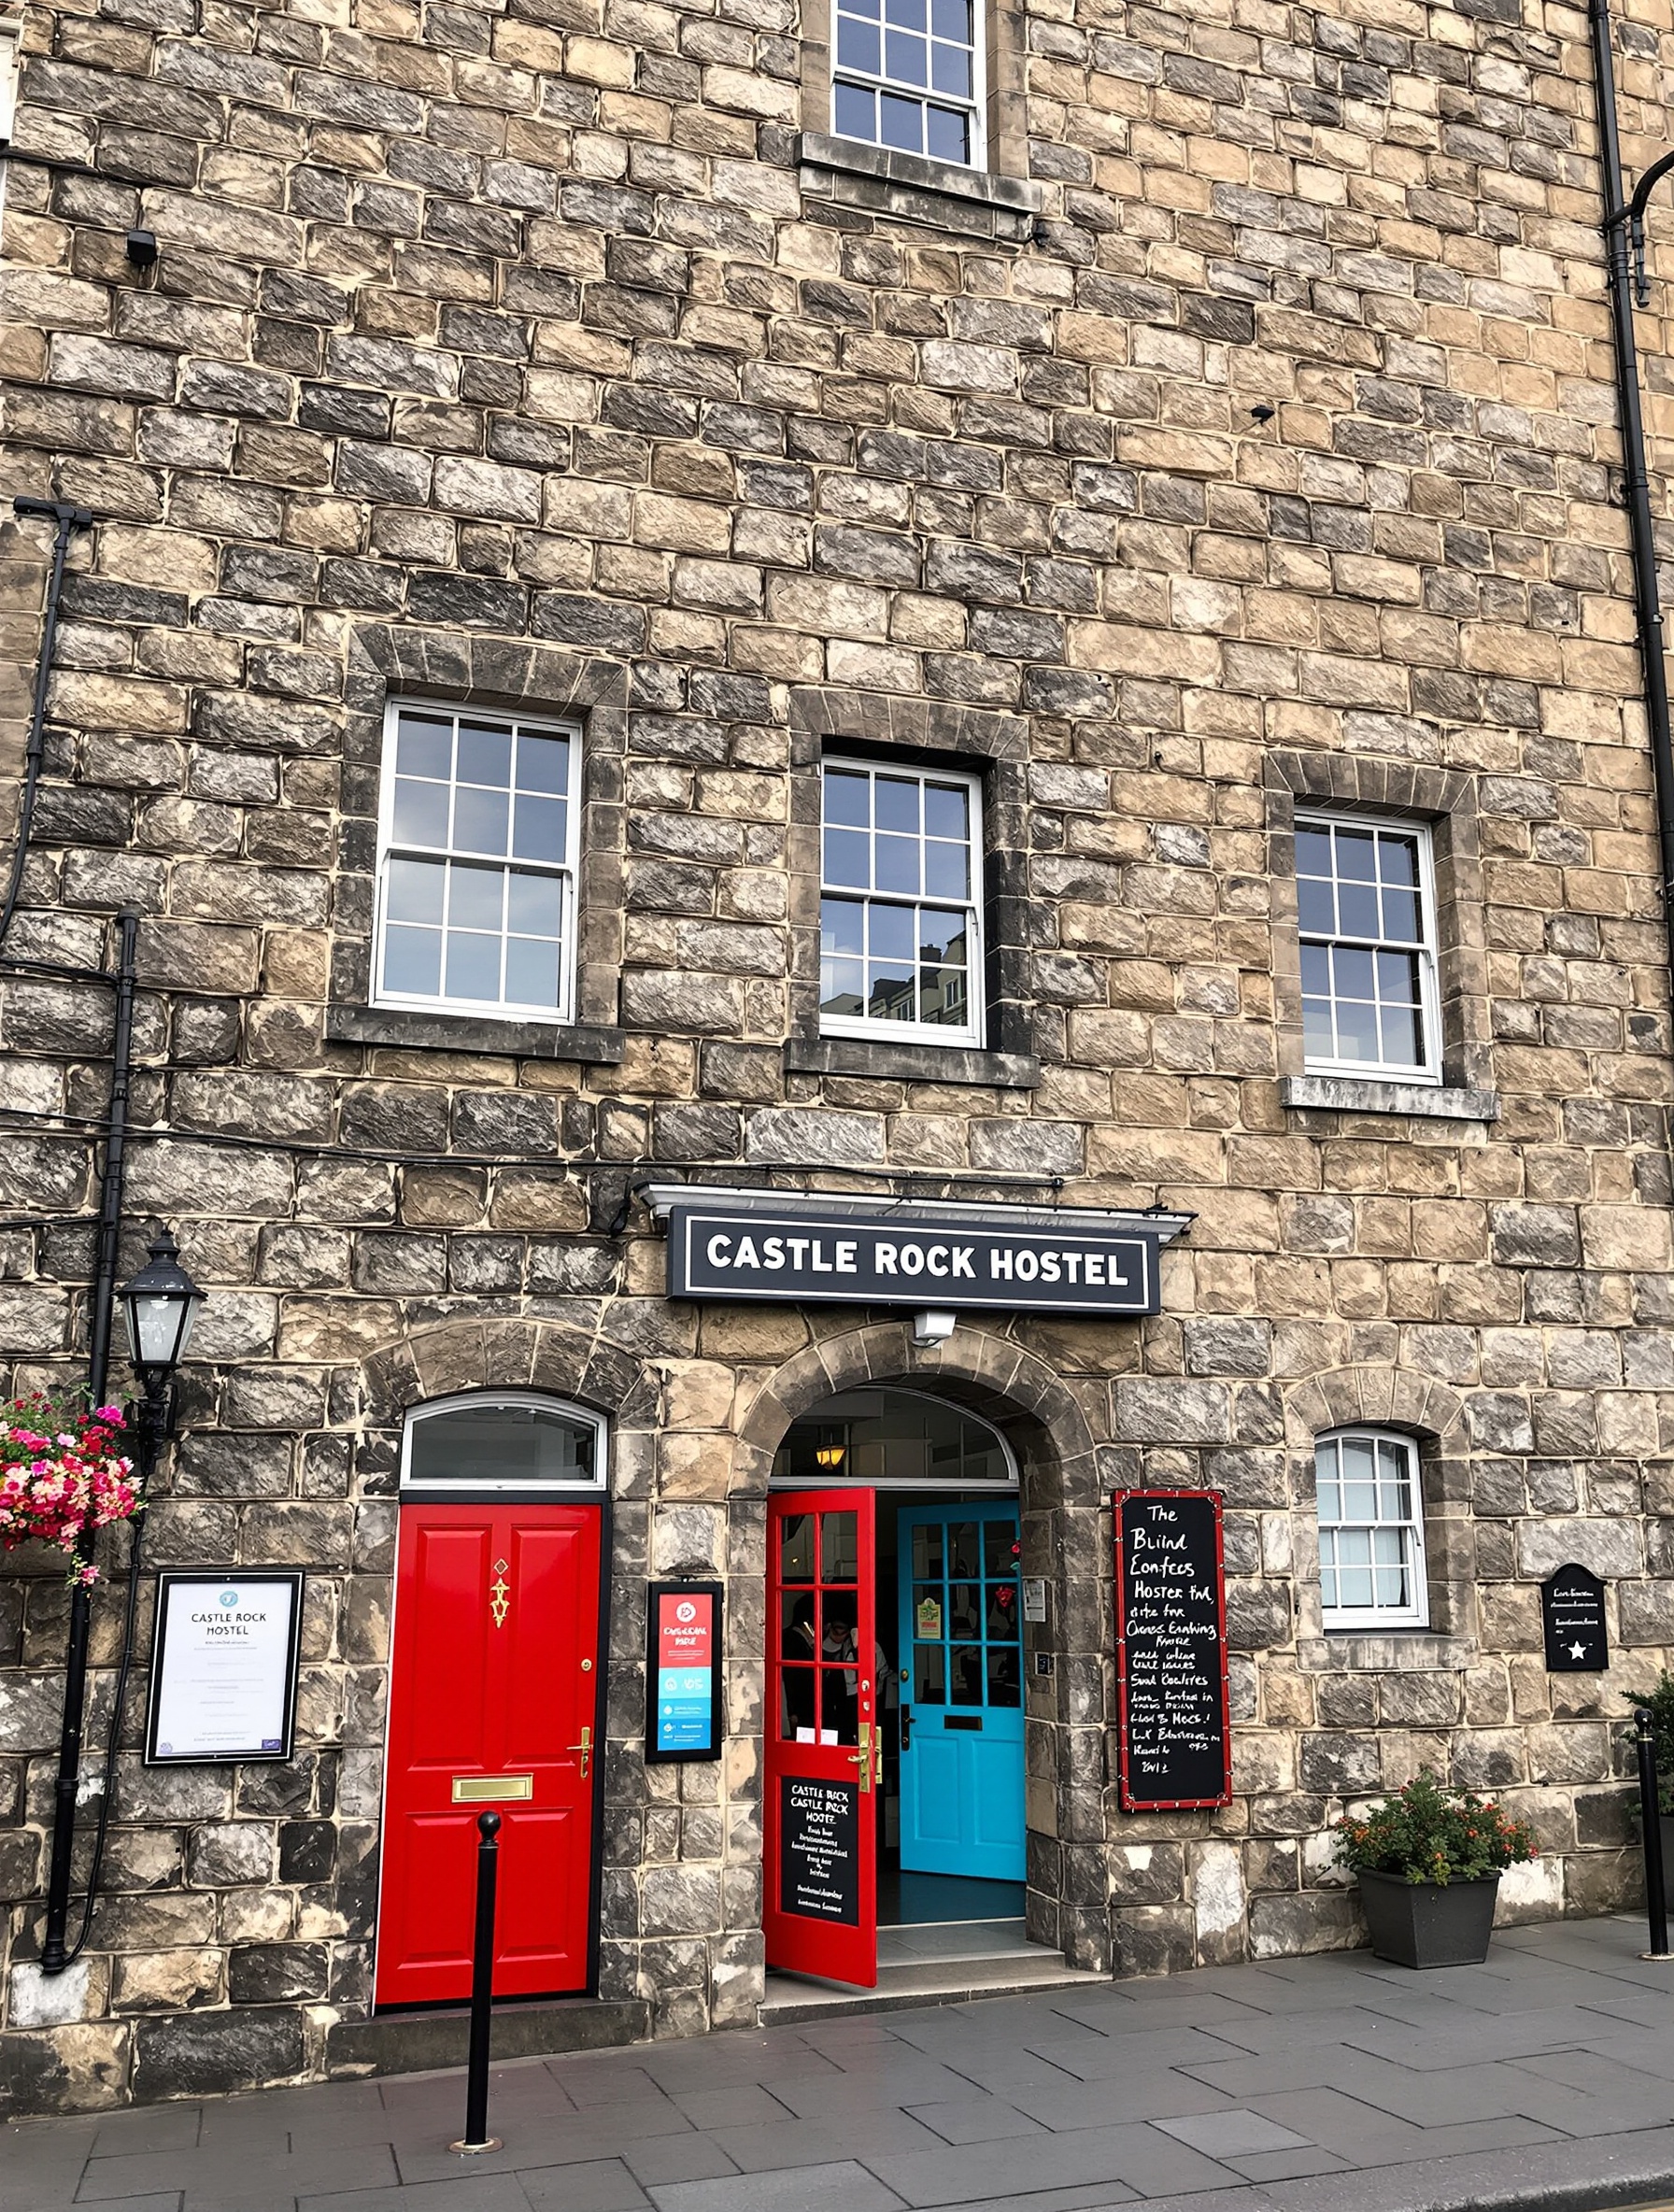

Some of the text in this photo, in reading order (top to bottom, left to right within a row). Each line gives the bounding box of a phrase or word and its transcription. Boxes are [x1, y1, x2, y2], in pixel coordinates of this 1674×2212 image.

[706, 1233, 1128, 1287] CASTLE ROCK HOSTEL
[1147, 1505, 1178, 1521] The
[191, 1612, 267, 1624] CASTLE ROCK
[206, 1625, 249, 1636] HOSTEL
